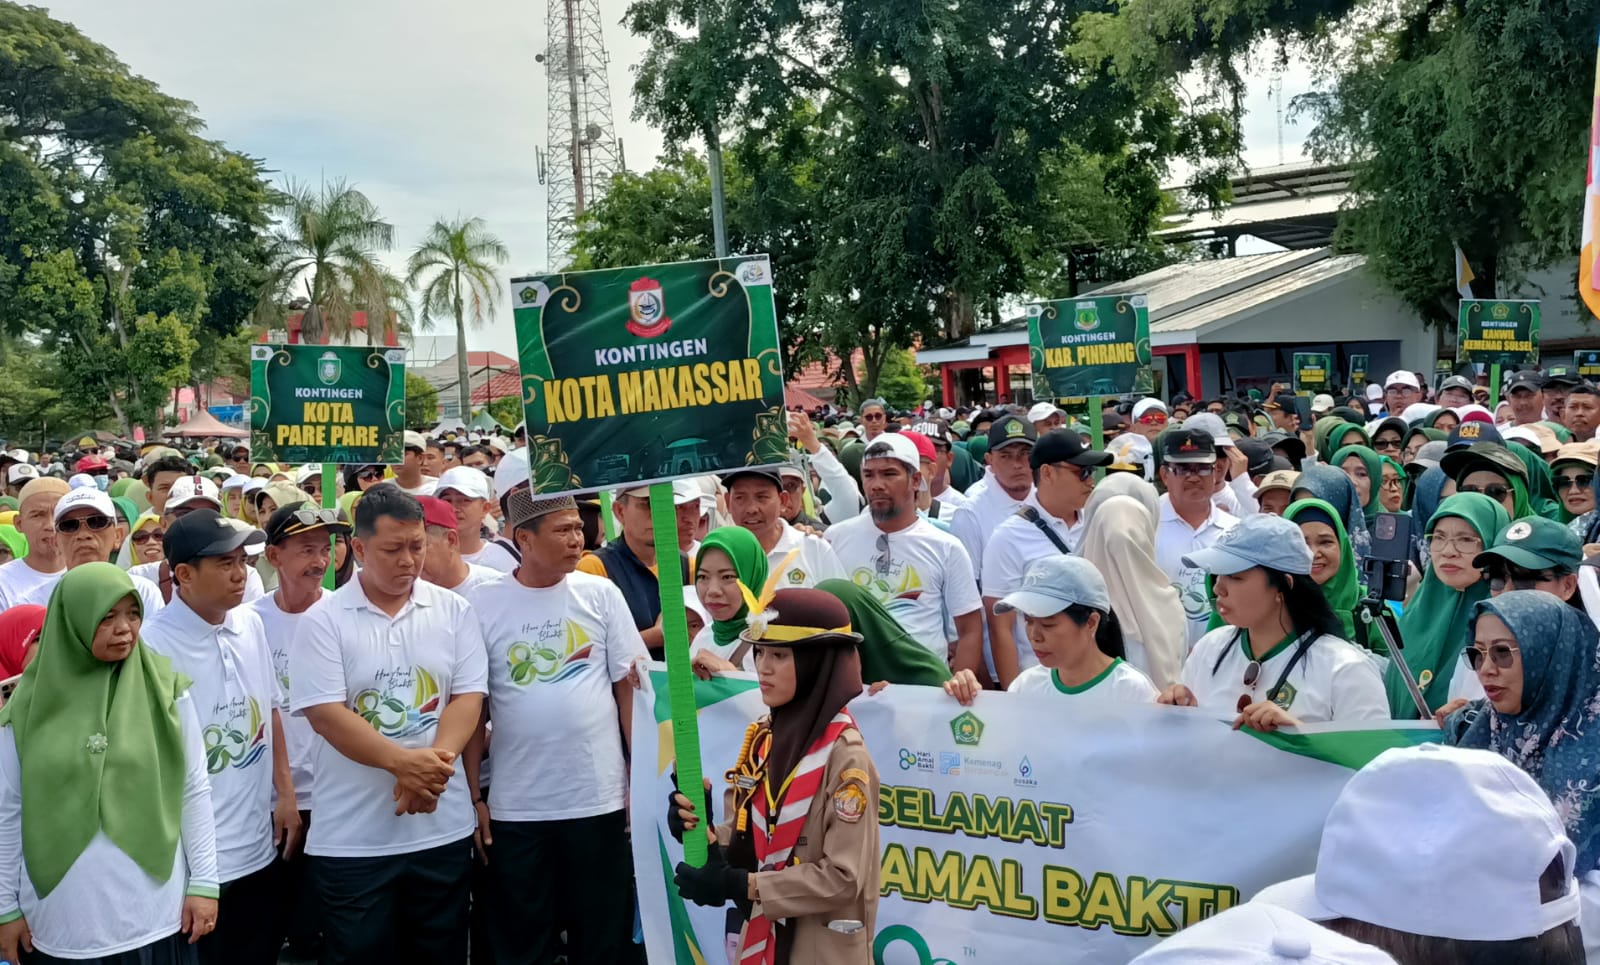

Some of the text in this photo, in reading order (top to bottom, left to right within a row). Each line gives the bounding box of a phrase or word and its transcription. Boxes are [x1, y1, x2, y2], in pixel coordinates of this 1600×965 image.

[1061, 332, 1116, 344] KONTINGEN
[1482, 329, 1515, 340] KANWIL
[595, 338, 708, 366] KONTINGEN
[1463, 340, 1533, 352] KEMENAG SULSEL
[1045, 342, 1135, 368] KAB. PINRANG
[295, 387, 363, 399] KONTINGEN
[543, 358, 763, 424] KOTA MAKASSAR
[303, 402, 354, 423] KOTA
[277, 425, 379, 446] PARE PARE
[964, 757, 1002, 769] Kemenag
[1013, 778, 1038, 786] pusaka
[879, 784, 1074, 849] SELAMAT
[880, 842, 1038, 919] AMAL
[963, 946, 976, 957] TH
